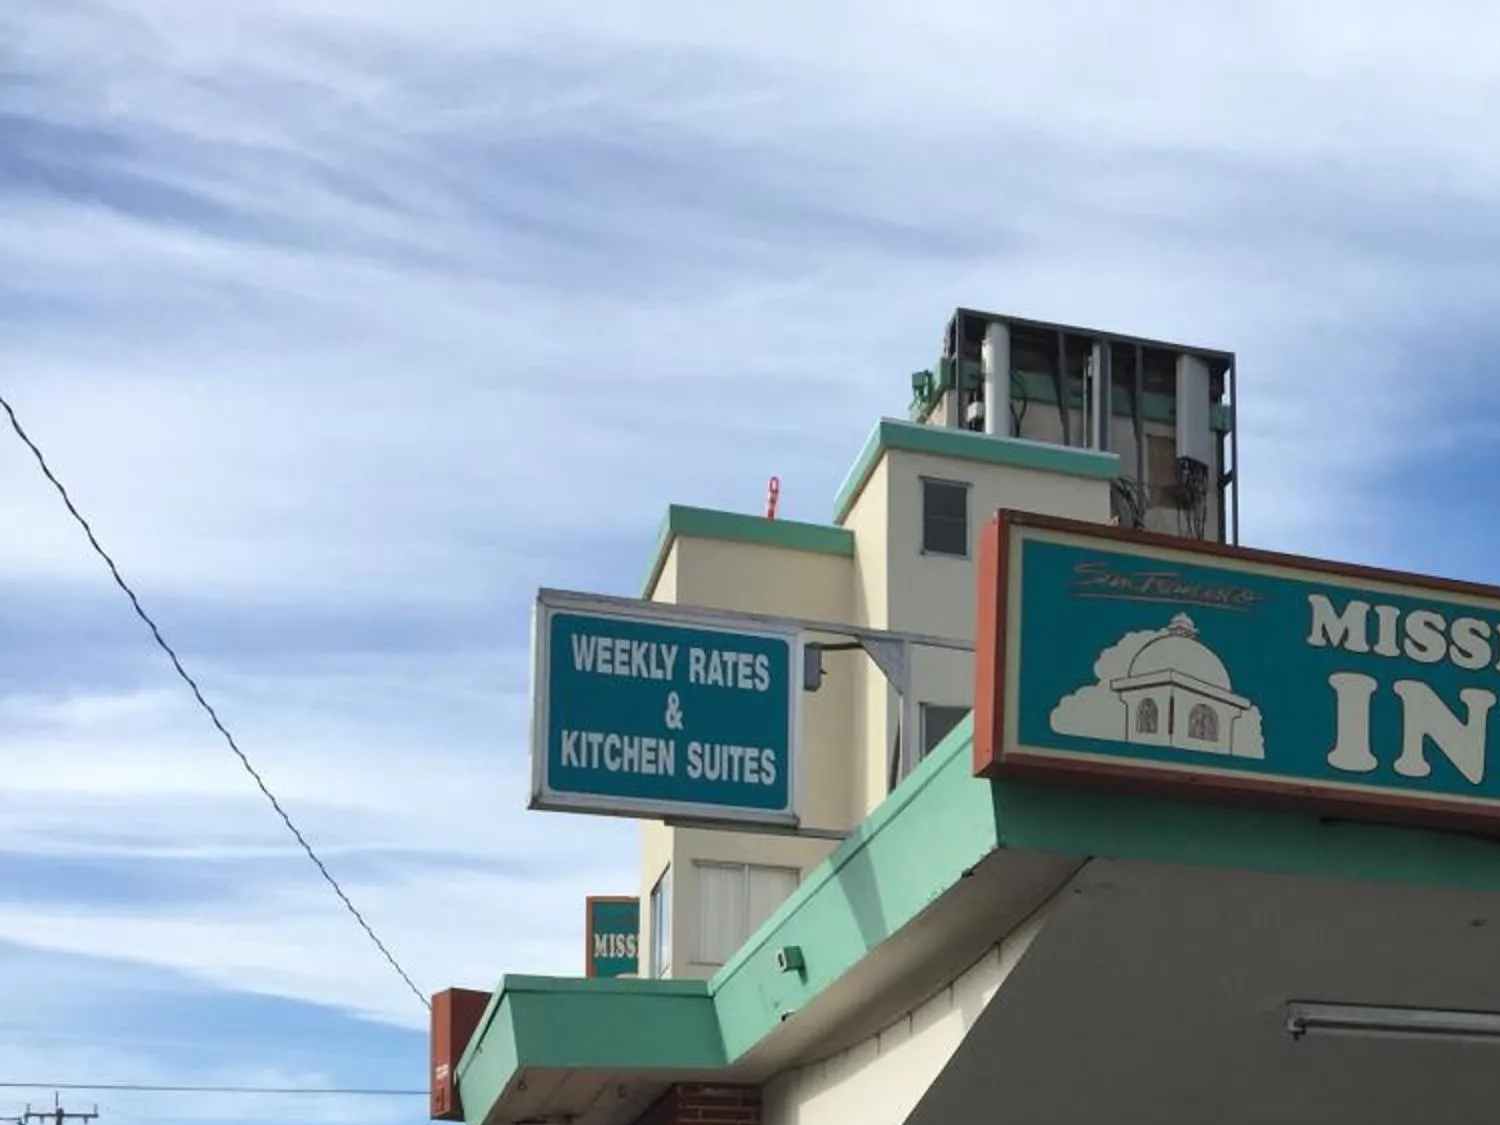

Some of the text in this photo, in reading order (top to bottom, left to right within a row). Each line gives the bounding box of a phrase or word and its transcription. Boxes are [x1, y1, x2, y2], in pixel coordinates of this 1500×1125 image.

[571, 633, 771, 692] WEEKLY RATES
[665, 691, 684, 730] &
[561, 730, 777, 785] KITCHEN SUITES
